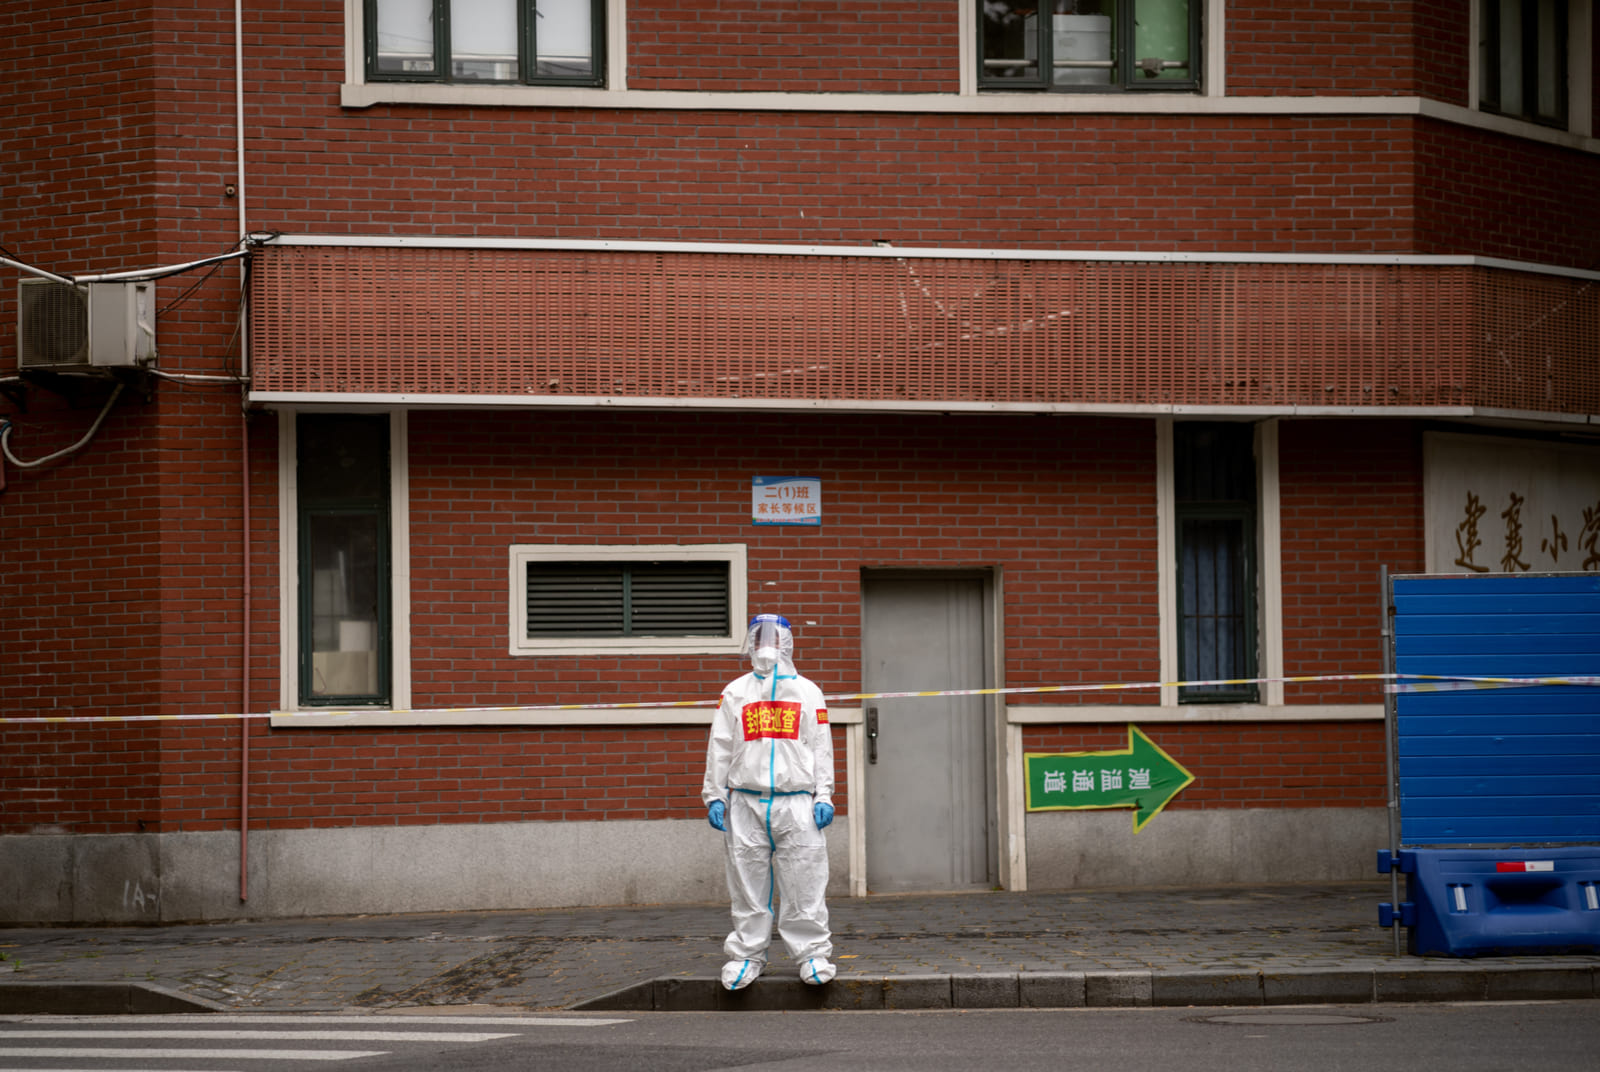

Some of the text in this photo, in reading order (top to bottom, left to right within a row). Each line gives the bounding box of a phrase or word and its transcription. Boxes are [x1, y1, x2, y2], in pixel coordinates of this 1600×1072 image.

[757, 502, 817, 514] 家长等候区
[1044, 768, 1151, 793] 测温通道
